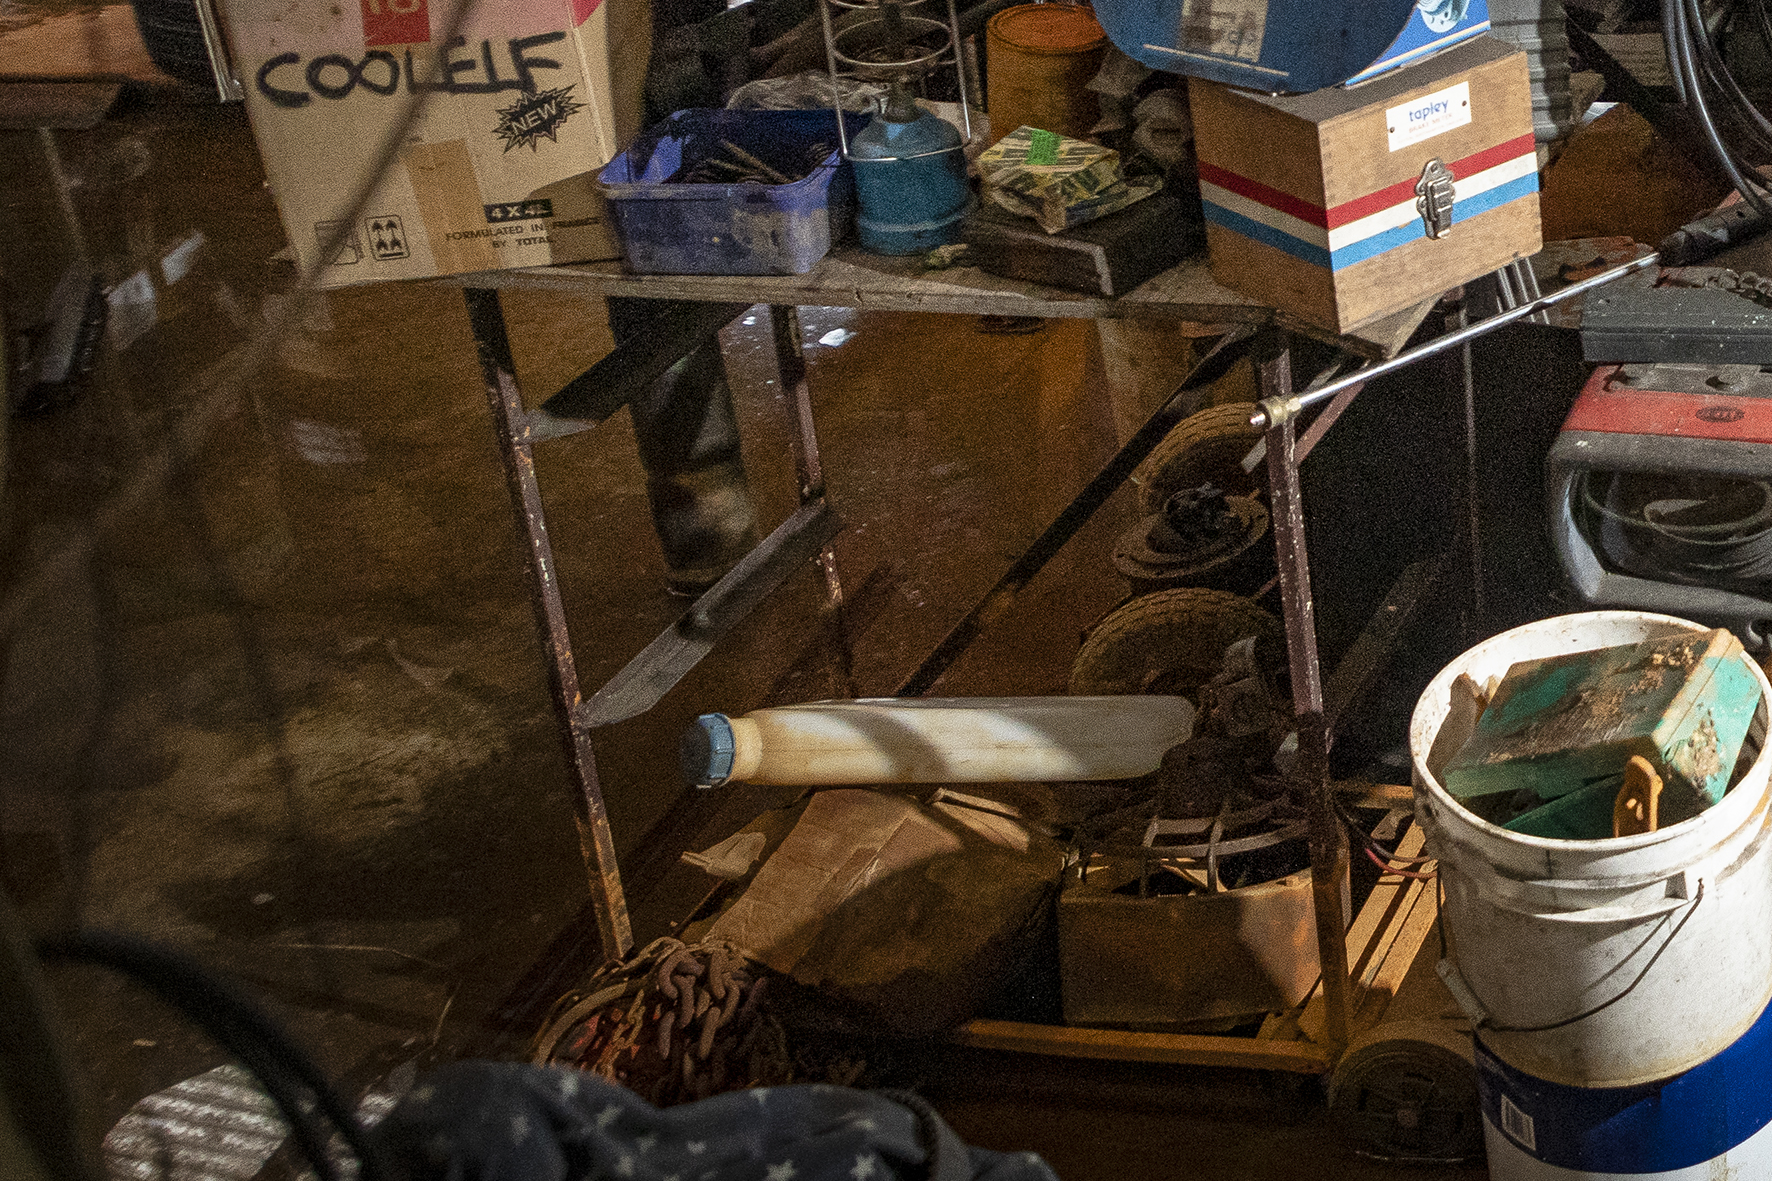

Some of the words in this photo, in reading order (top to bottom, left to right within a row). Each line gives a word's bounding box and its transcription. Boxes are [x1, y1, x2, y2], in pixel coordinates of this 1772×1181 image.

[511, 101, 558, 133] NEW
[1409, 99, 1449, 122] tapley
[491, 207, 503, 218] 4
[445, 225, 524, 241] FORMULATED
[531, 223, 544, 232] IN
[492, 240, 507, 248] BY
